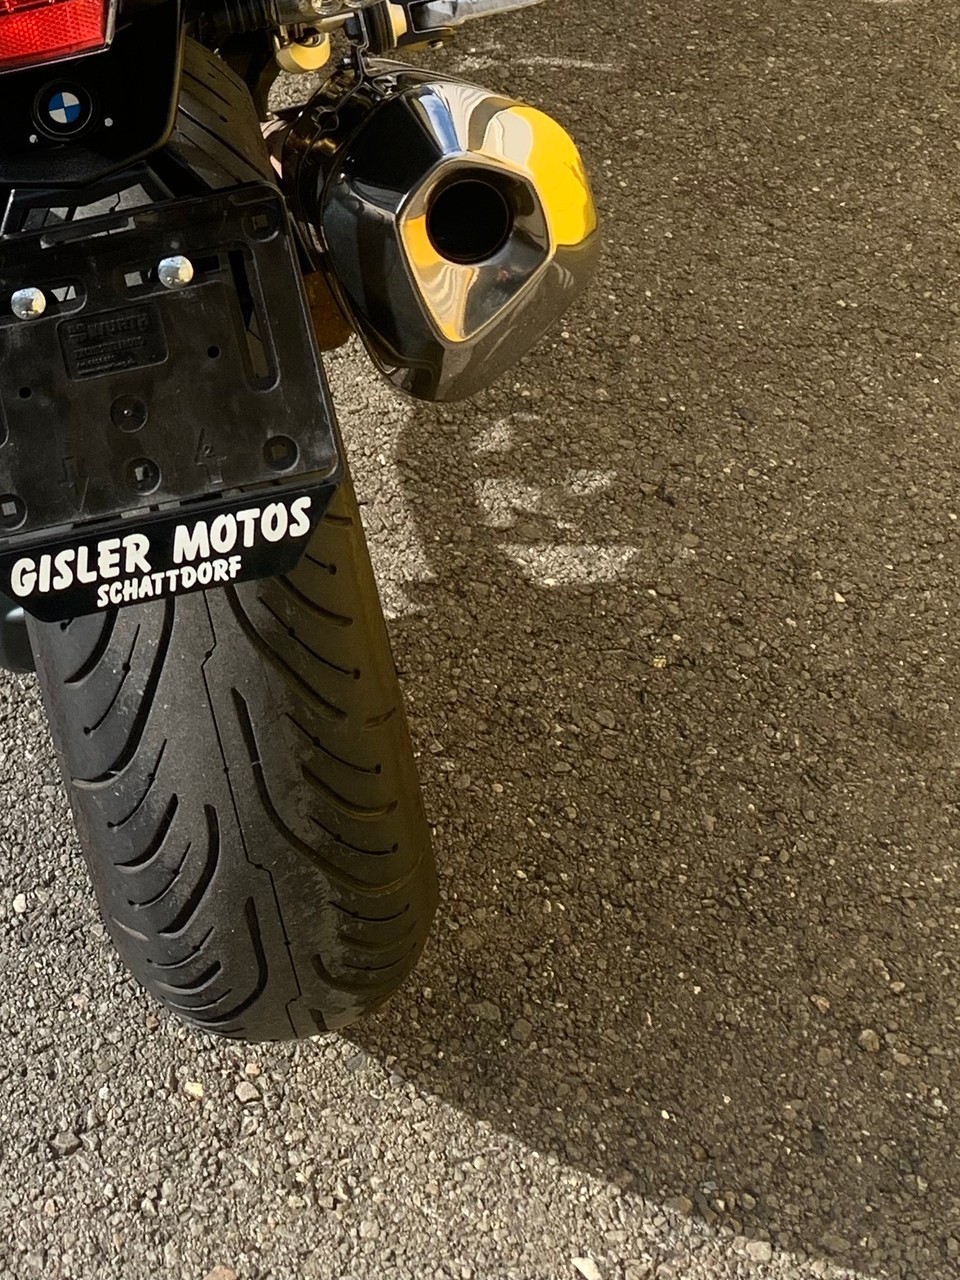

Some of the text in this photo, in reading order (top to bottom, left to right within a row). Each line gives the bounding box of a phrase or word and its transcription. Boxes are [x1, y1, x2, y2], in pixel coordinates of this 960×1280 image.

[10, 496, 312, 597] GISLER MOTOS
[96, 555, 242, 608] SCHATTDORF
